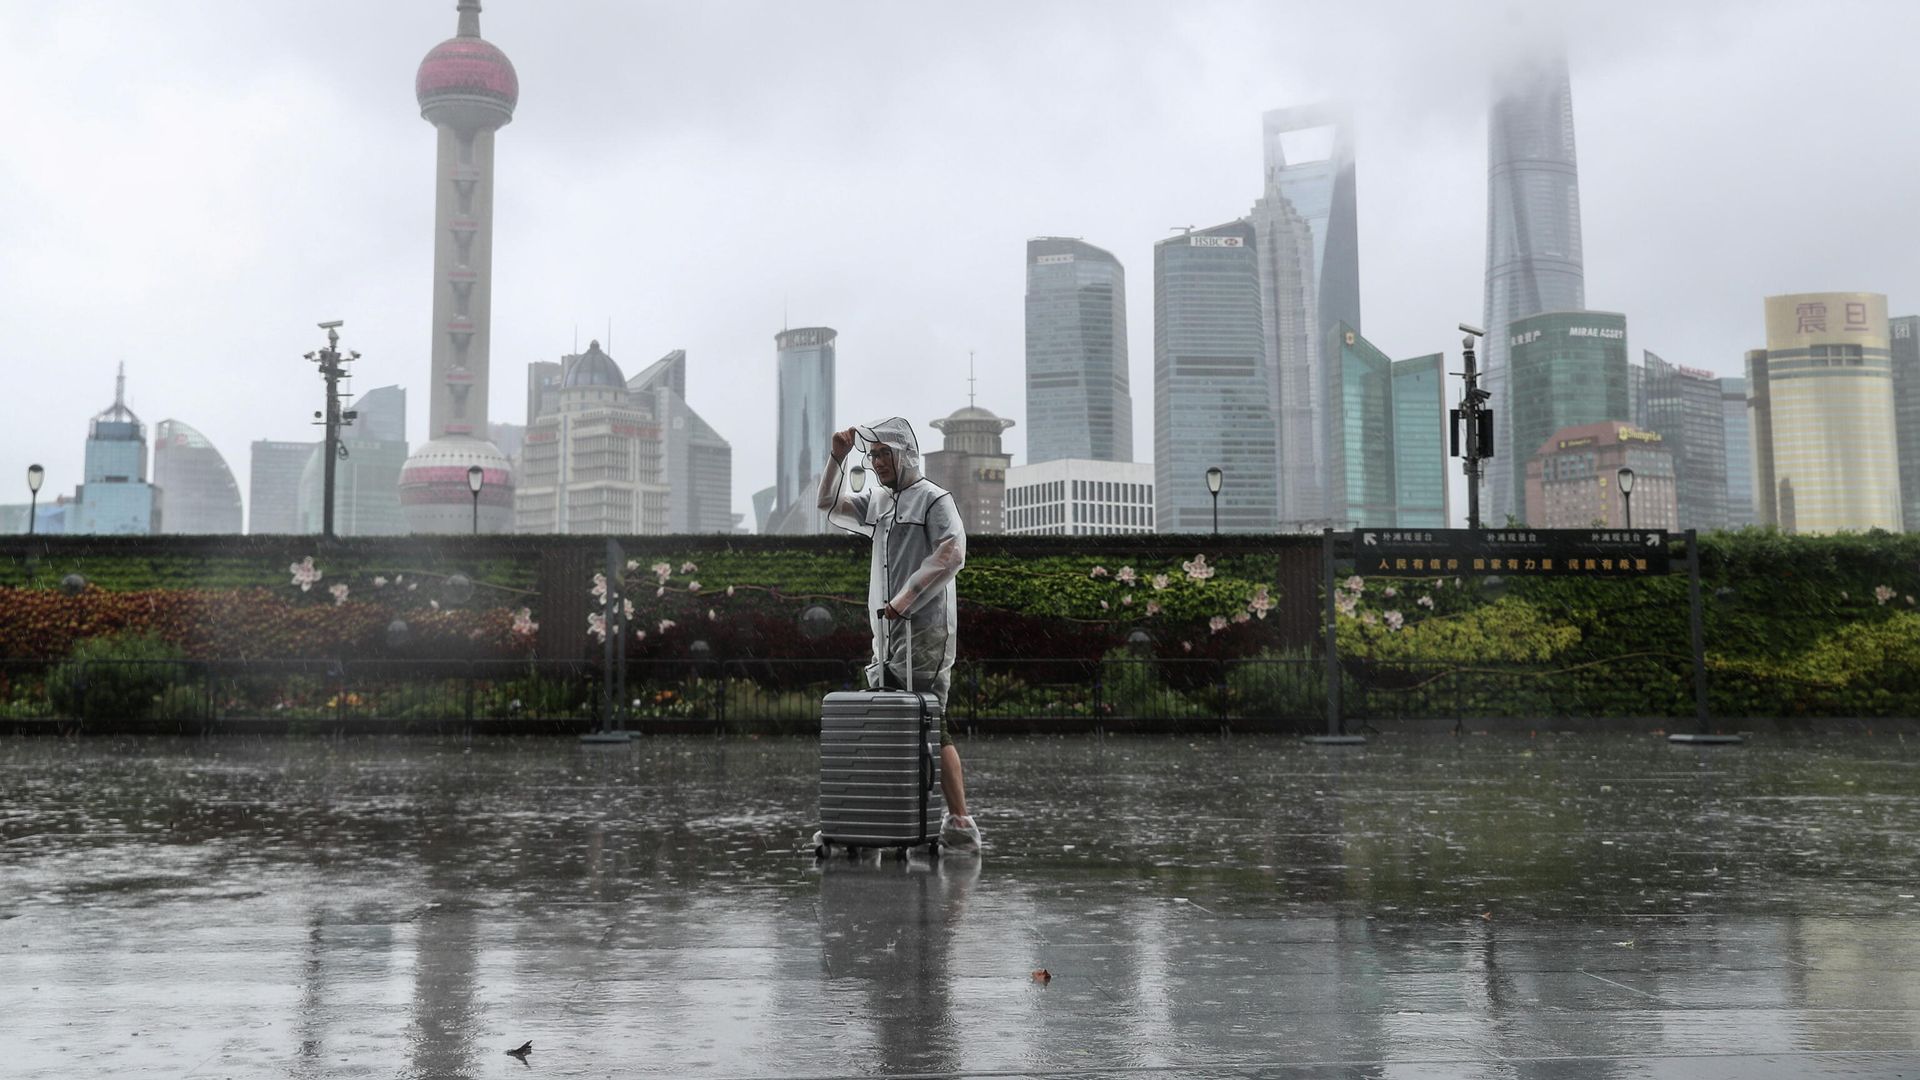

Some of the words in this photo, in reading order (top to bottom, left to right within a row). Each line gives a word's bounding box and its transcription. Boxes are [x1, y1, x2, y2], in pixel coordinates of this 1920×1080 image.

[1194, 237, 1223, 246] HSBC
[1795, 302, 1869, 333] 震旦
[1569, 327, 1598, 337] MIRAE
[1599, 329, 1624, 339] ASSET
[1378, 558, 1458, 570] 人民有信仰
